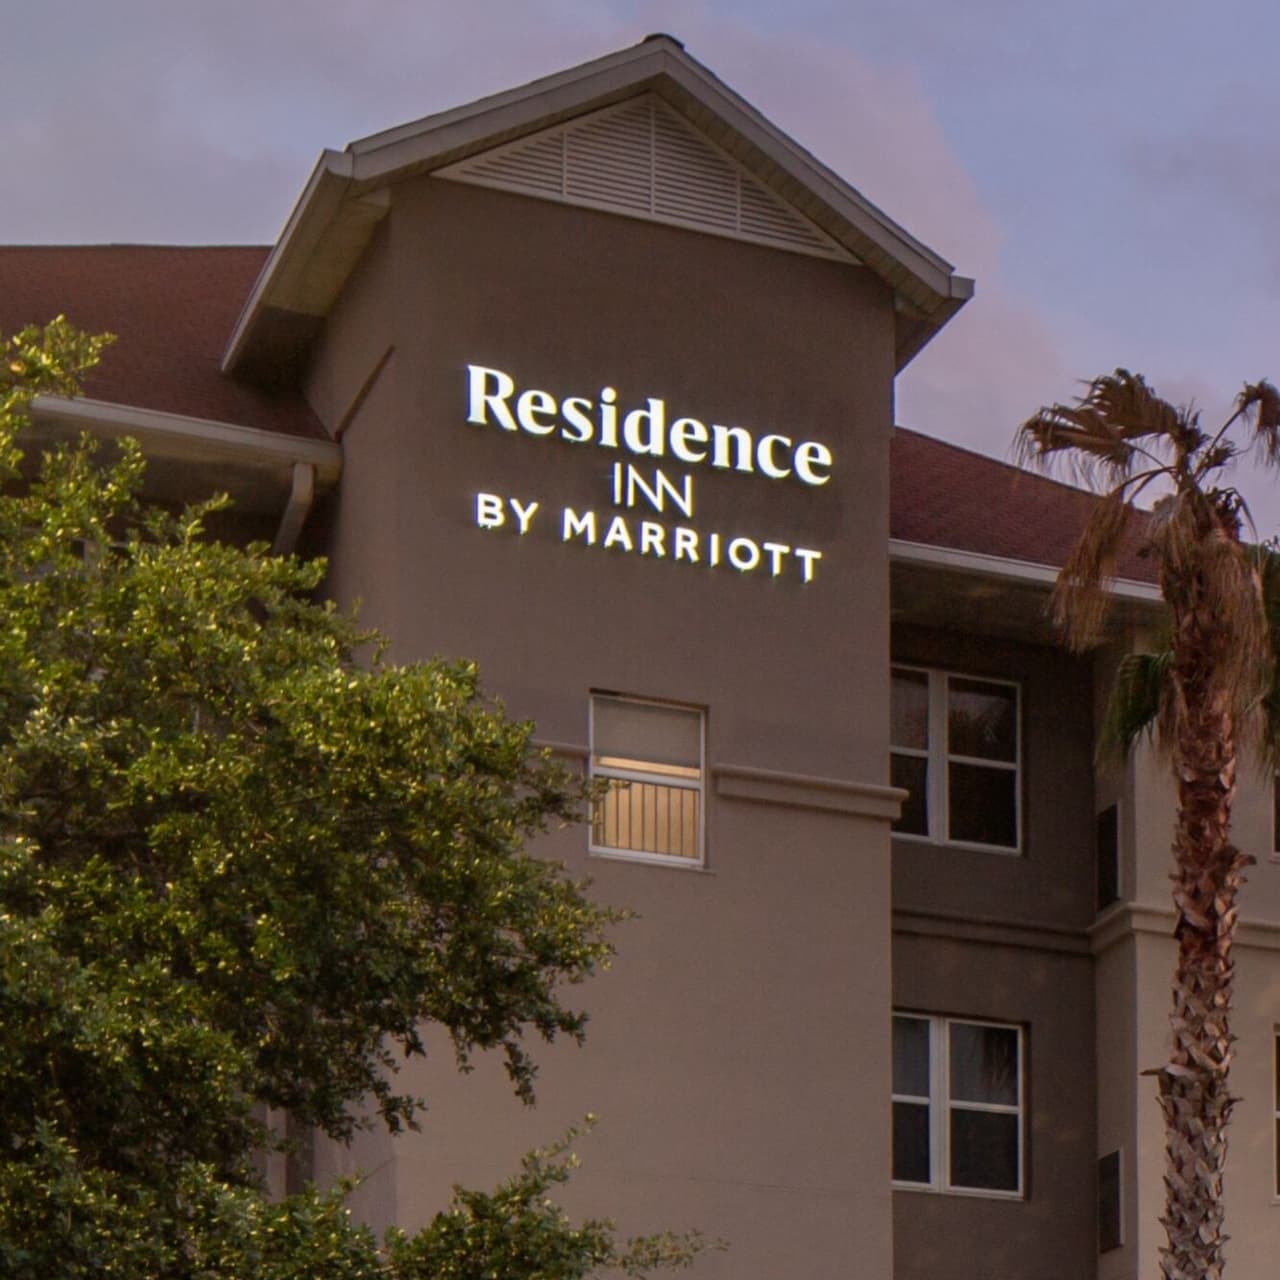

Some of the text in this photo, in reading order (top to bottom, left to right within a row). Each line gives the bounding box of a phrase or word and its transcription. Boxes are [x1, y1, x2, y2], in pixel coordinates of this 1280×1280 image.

[466, 363, 833, 486] Residence
[610, 461, 694, 519] INN
[475, 492, 822, 583] BY MARRIOTT
